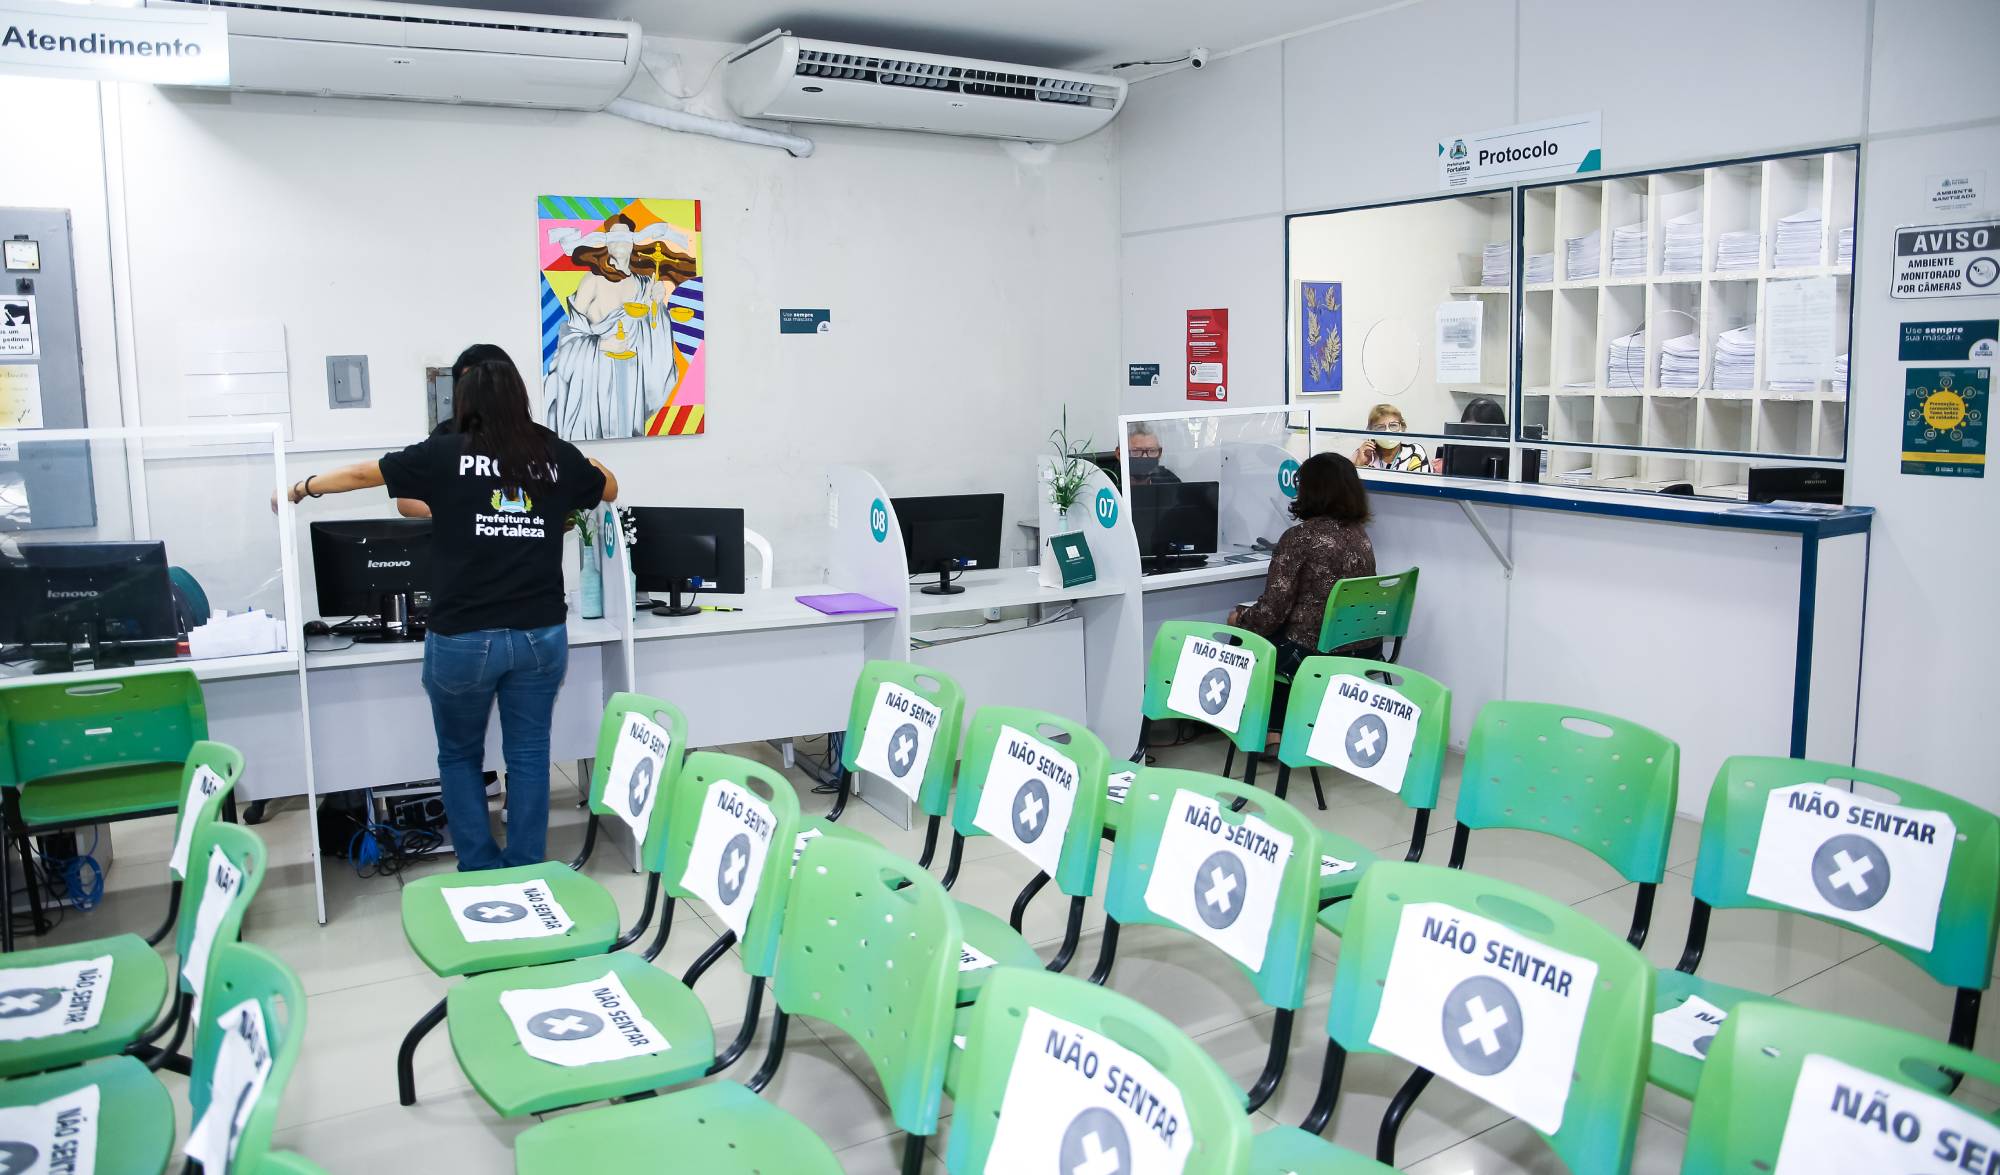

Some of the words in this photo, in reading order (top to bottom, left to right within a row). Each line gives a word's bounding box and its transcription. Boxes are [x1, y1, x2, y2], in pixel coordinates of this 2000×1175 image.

[2, 25, 202, 57] Atendimento
[1479, 140, 1558, 166] Protocolo
[1912, 229, 1989, 253] AVISO
[1900, 269, 1960, 281] MONITORADO
[1908, 257, 1954, 268] AMBIENTE
[1897, 285, 1915, 293] POR
[1918, 281, 1961, 292] CÂMERAS
[1925, 327, 1964, 335] sempre
[475, 513, 531, 525] Prefeitura
[533, 516, 545, 526] de
[872, 508, 886, 532] 08
[1099, 497, 1115, 519] 07
[475, 523, 545, 538] Fortaleza
[605, 521, 614, 546] 09
[367, 560, 411, 568] lenovo
[47, 589, 98, 598] lenovo
[1193, 641, 1217, 659] NÃO
[1218, 650, 1250, 670] SENTAR
[885, 691, 909, 717] NÃO
[1339, 682, 1369, 703] NÃO
[1370, 693, 1413, 720] SENTAR
[629, 722, 650, 745] NÃO
[1007, 740, 1036, 766] NÃO
[1036, 755, 1073, 791] SENTAR
[717, 790, 743, 819] NÃO
[1788, 791, 1840, 820] NÃO
[1846, 806, 1936, 845] SENTAR
[1184, 805, 1222, 835] NÃO
[1224, 825, 1279, 864] SENTAR
[523, 887, 545, 903] NÃO
[532, 902, 562, 930] SENTAR
[1421, 916, 1477, 955] NÃO
[1483, 939, 1574, 998] SENTAR
[76, 967, 102, 989] NÃO
[64, 989, 93, 1026] SENTAR
[591, 987, 621, 1009] NÃO
[607, 1009, 650, 1047] SENTAR
[1044, 1029, 1099, 1080] NÃO
[1104, 1064, 1178, 1149] SENTAR
[54, 1107, 88, 1137] NÃO
[1830, 1084, 1921, 1144] NÃO
